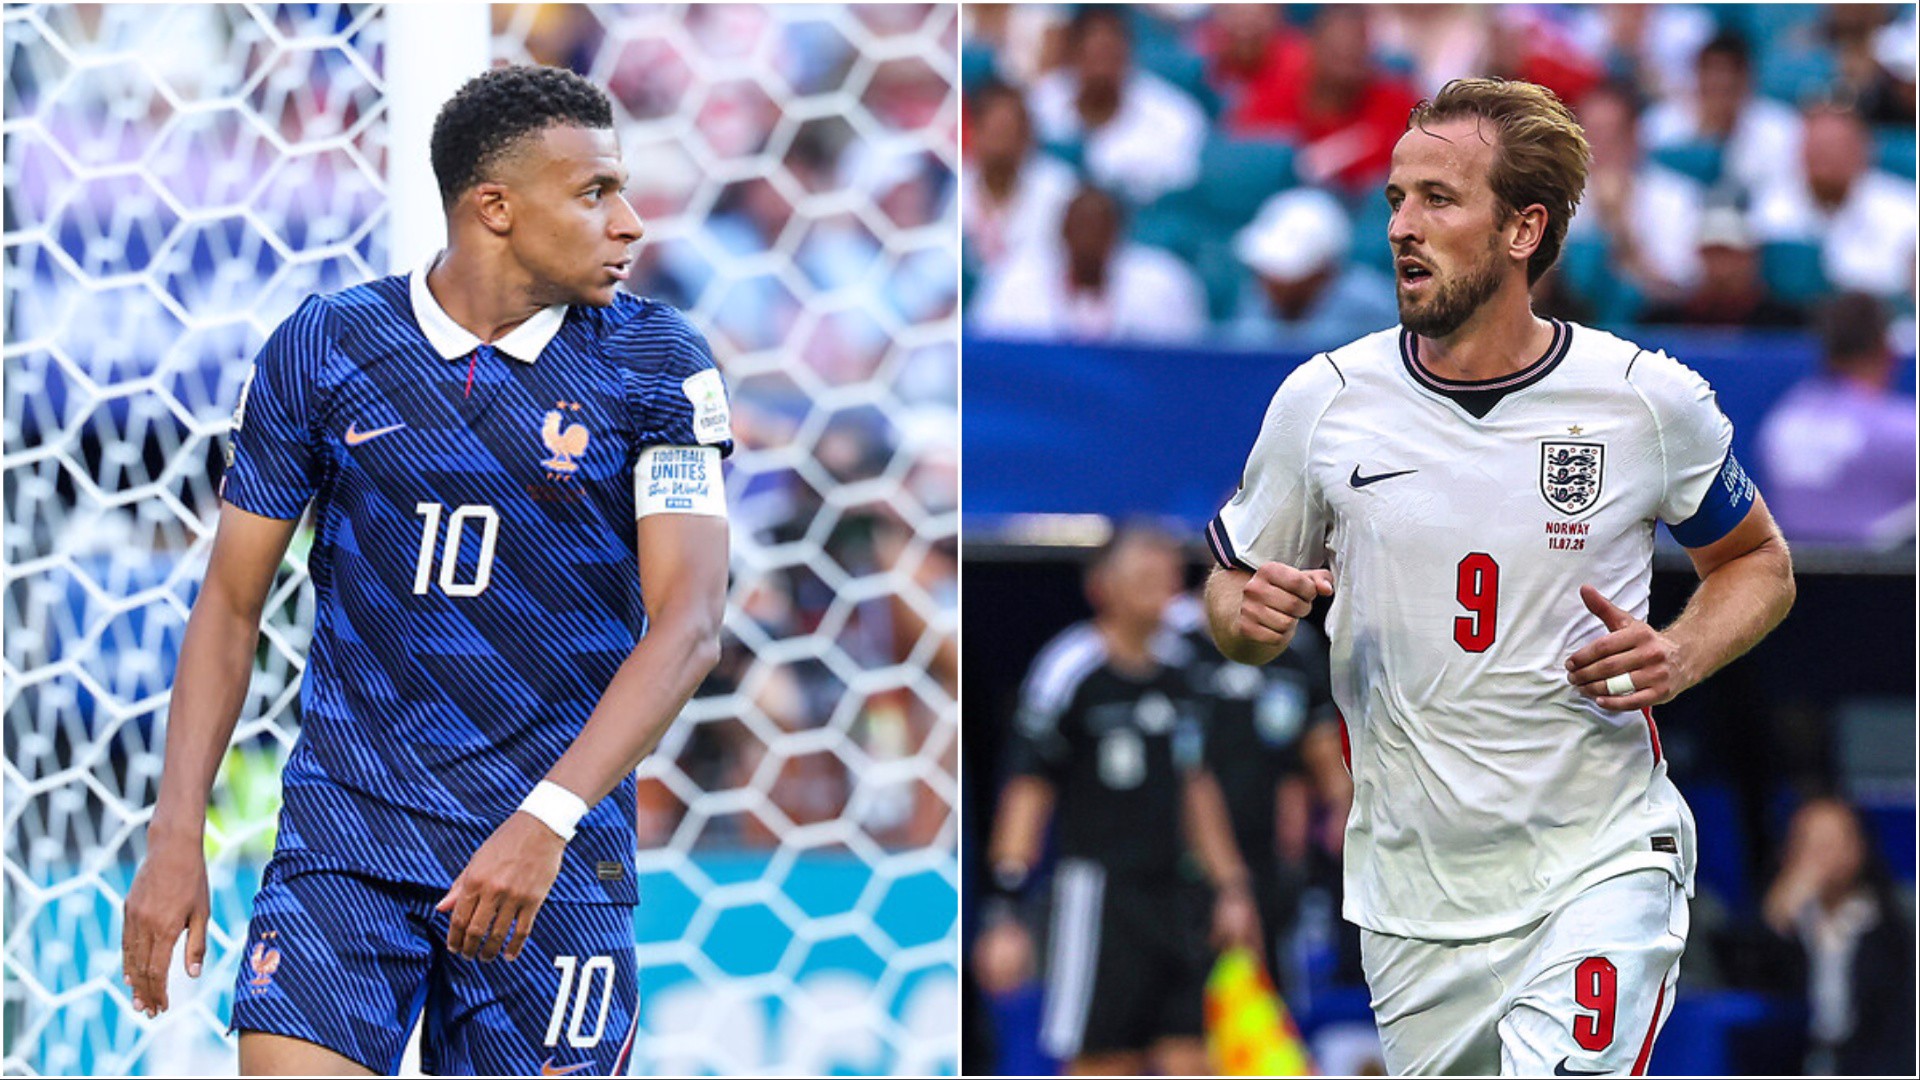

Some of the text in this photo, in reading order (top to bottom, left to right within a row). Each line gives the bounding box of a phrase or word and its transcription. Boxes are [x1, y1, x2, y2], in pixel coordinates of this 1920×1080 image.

[651, 463, 706, 481] UNITES
[653, 450, 705, 462] FOOTBALL
[413, 502, 499, 596] 10
[1545, 521, 1590, 535] NORWAY
[1548, 537, 1586, 551] 11.07.26
[1453, 551, 1500, 653] 9
[544, 955, 615, 1048] 10
[1572, 956, 1617, 1052] 9
